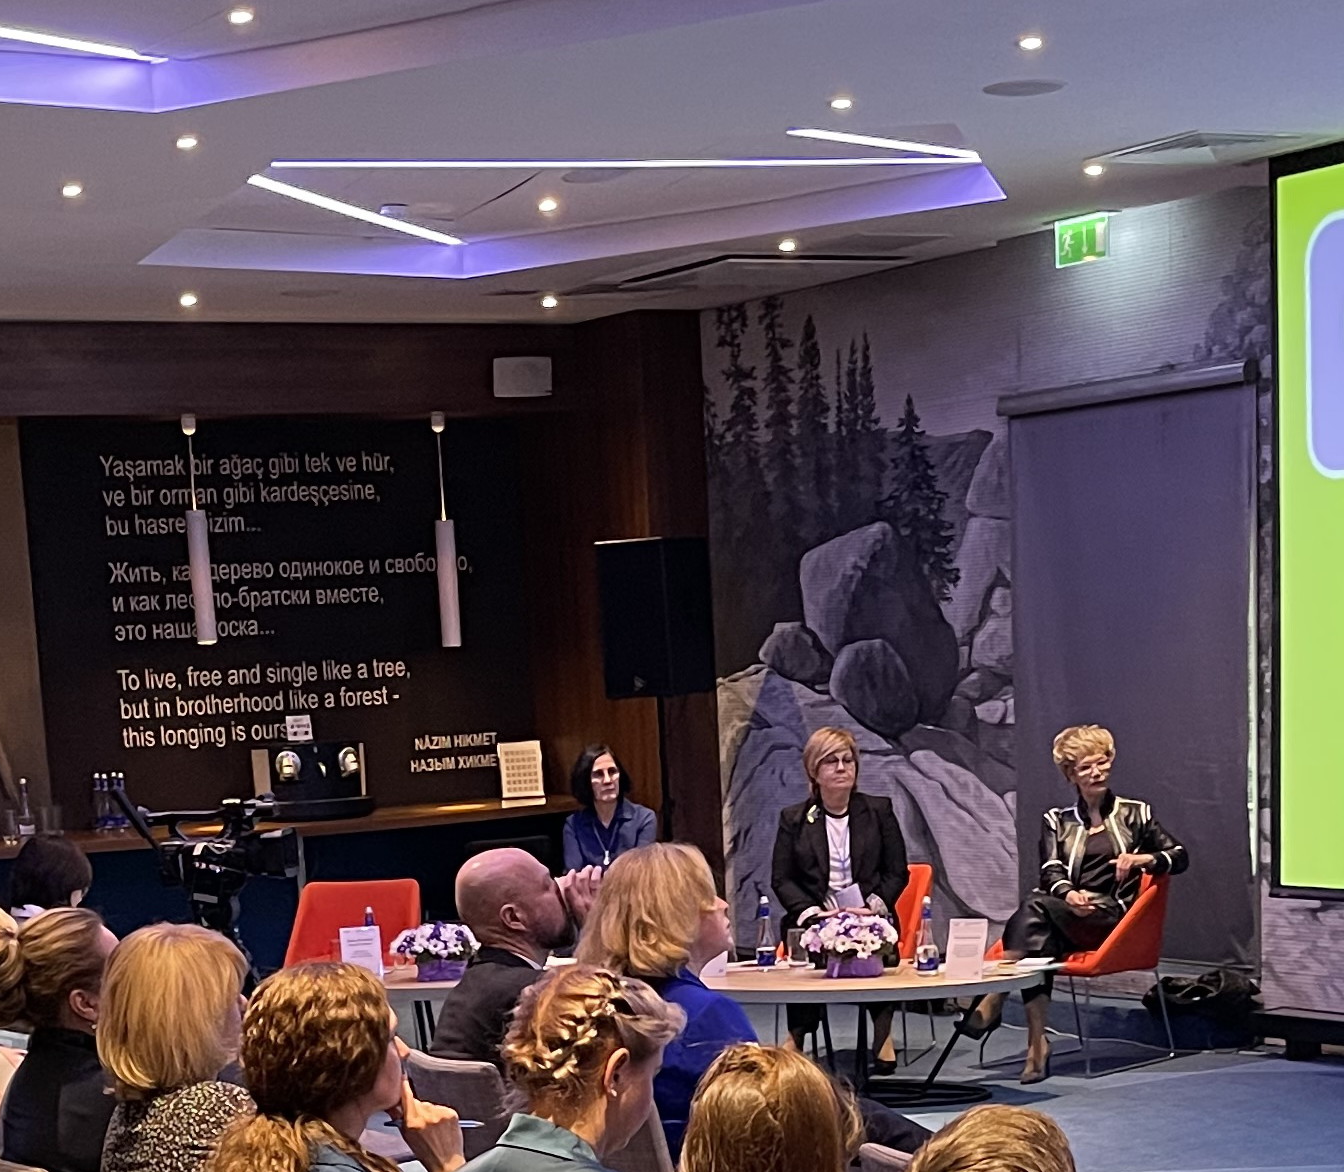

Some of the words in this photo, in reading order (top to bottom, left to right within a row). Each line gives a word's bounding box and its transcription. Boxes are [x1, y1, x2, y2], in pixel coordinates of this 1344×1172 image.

[100, 454, 186, 482] Yaşamak
[190, 453, 214, 475] bir
[219, 454, 264, 479] ağaç
[268, 452, 299, 478] gibi
[306, 452, 332, 473] tek
[336, 455, 356, 473] ve
[102, 488, 125, 507] ve
[131, 484, 154, 506] bir
[159, 487, 218, 506] orman
[223, 482, 255, 509] gibi
[259, 480, 381, 506] kardeşçesine,
[105, 515, 129, 536] bu
[135, 513, 187, 536] hasre
[207, 511, 262, 533] izim...
[108, 561, 167, 585] Жить,
[279, 559, 364, 580] одинокое
[369, 558, 380, 574] и
[385, 552, 473, 574] свобоо,
[112, 595, 125, 613] и
[129, 594, 161, 612] как
[316, 586, 384, 606] вместе,
[114, 623, 147, 642] это
[217, 619, 275, 638] оска...
[116, 669, 140, 691] To
[144, 668, 182, 691] live,
[187, 666, 223, 687] free
[227, 663, 261, 686] and
[266, 660, 318, 687] single
[322, 659, 352, 681] like
[357, 662, 369, 679] a
[373, 659, 411, 680] tree,
[120, 698, 151, 720] but
[153, 697, 171, 718] in
[176, 690, 284, 717] brotherhood
[289, 689, 319, 710] like
[324, 692, 335, 708] a
[340, 686, 389, 707] forest
[123, 726, 155, 748] this
[160, 723, 226, 750] longing
[231, 721, 246, 742] is
[410, 756, 456, 773] НАЗЫМ
[457, 754, 498, 769] ХИКМЕ
